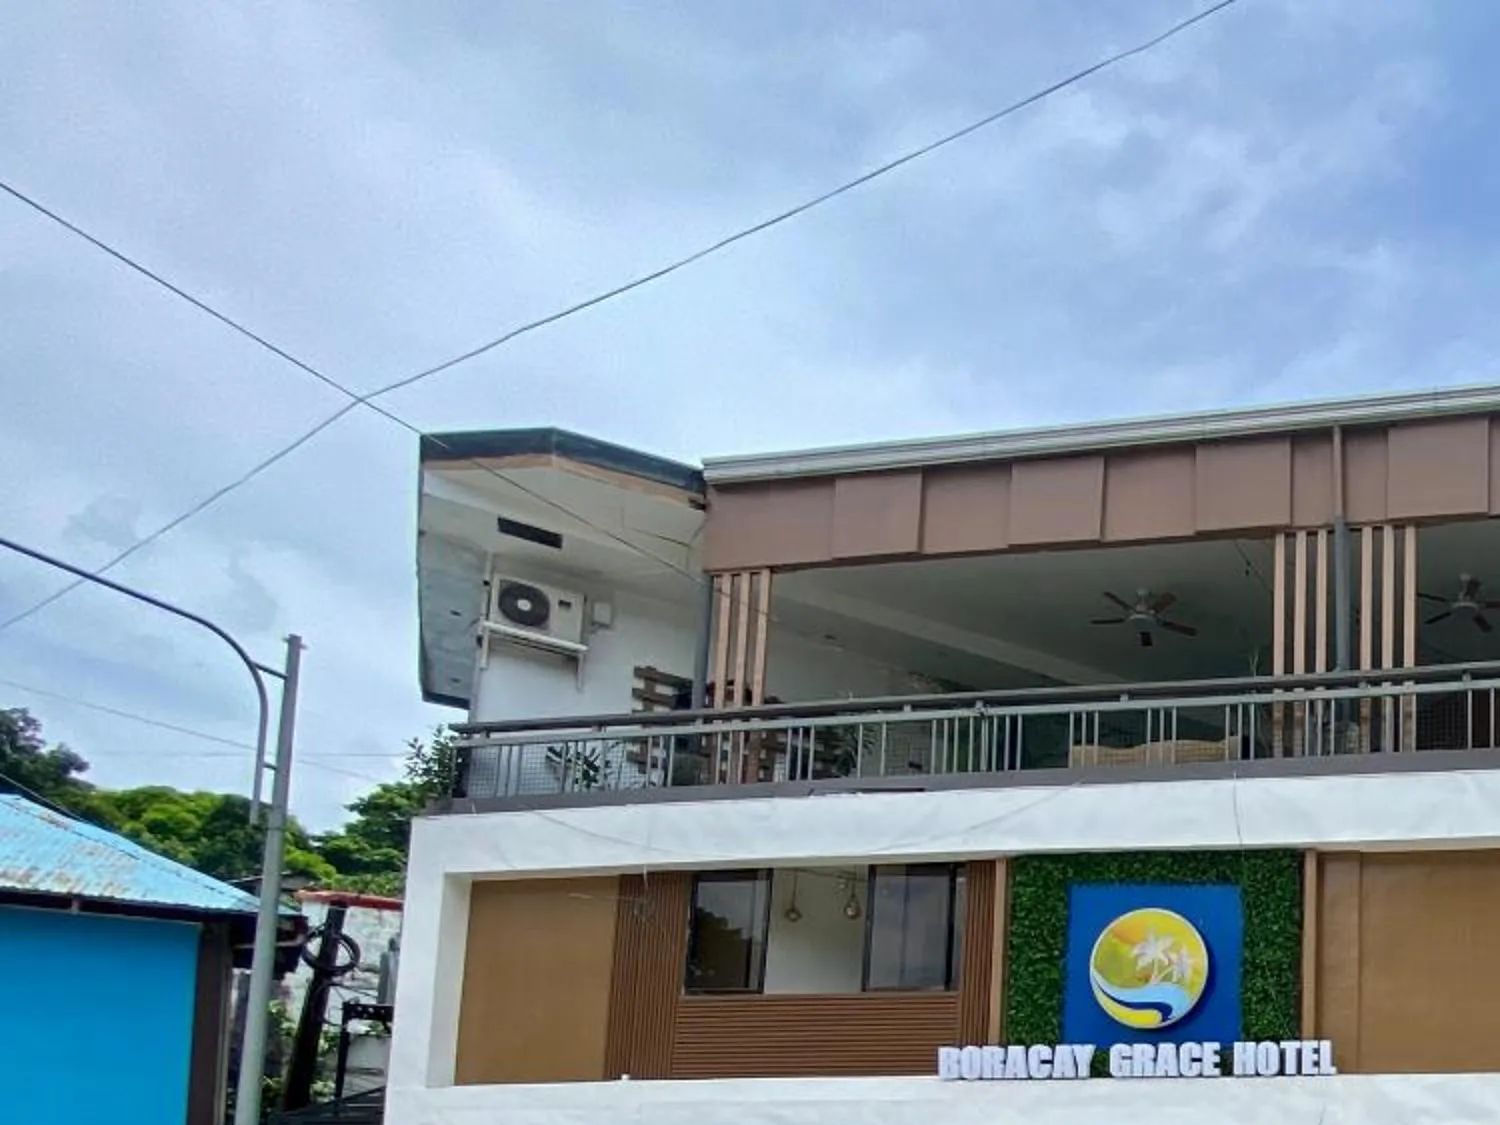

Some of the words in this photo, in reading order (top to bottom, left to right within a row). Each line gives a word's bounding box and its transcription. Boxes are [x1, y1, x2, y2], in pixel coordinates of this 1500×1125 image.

[938, 1043, 1095, 1080] BORACAY
[1108, 1042, 1222, 1078] GRACE
[1232, 1040, 1337, 1076] HOTEL
